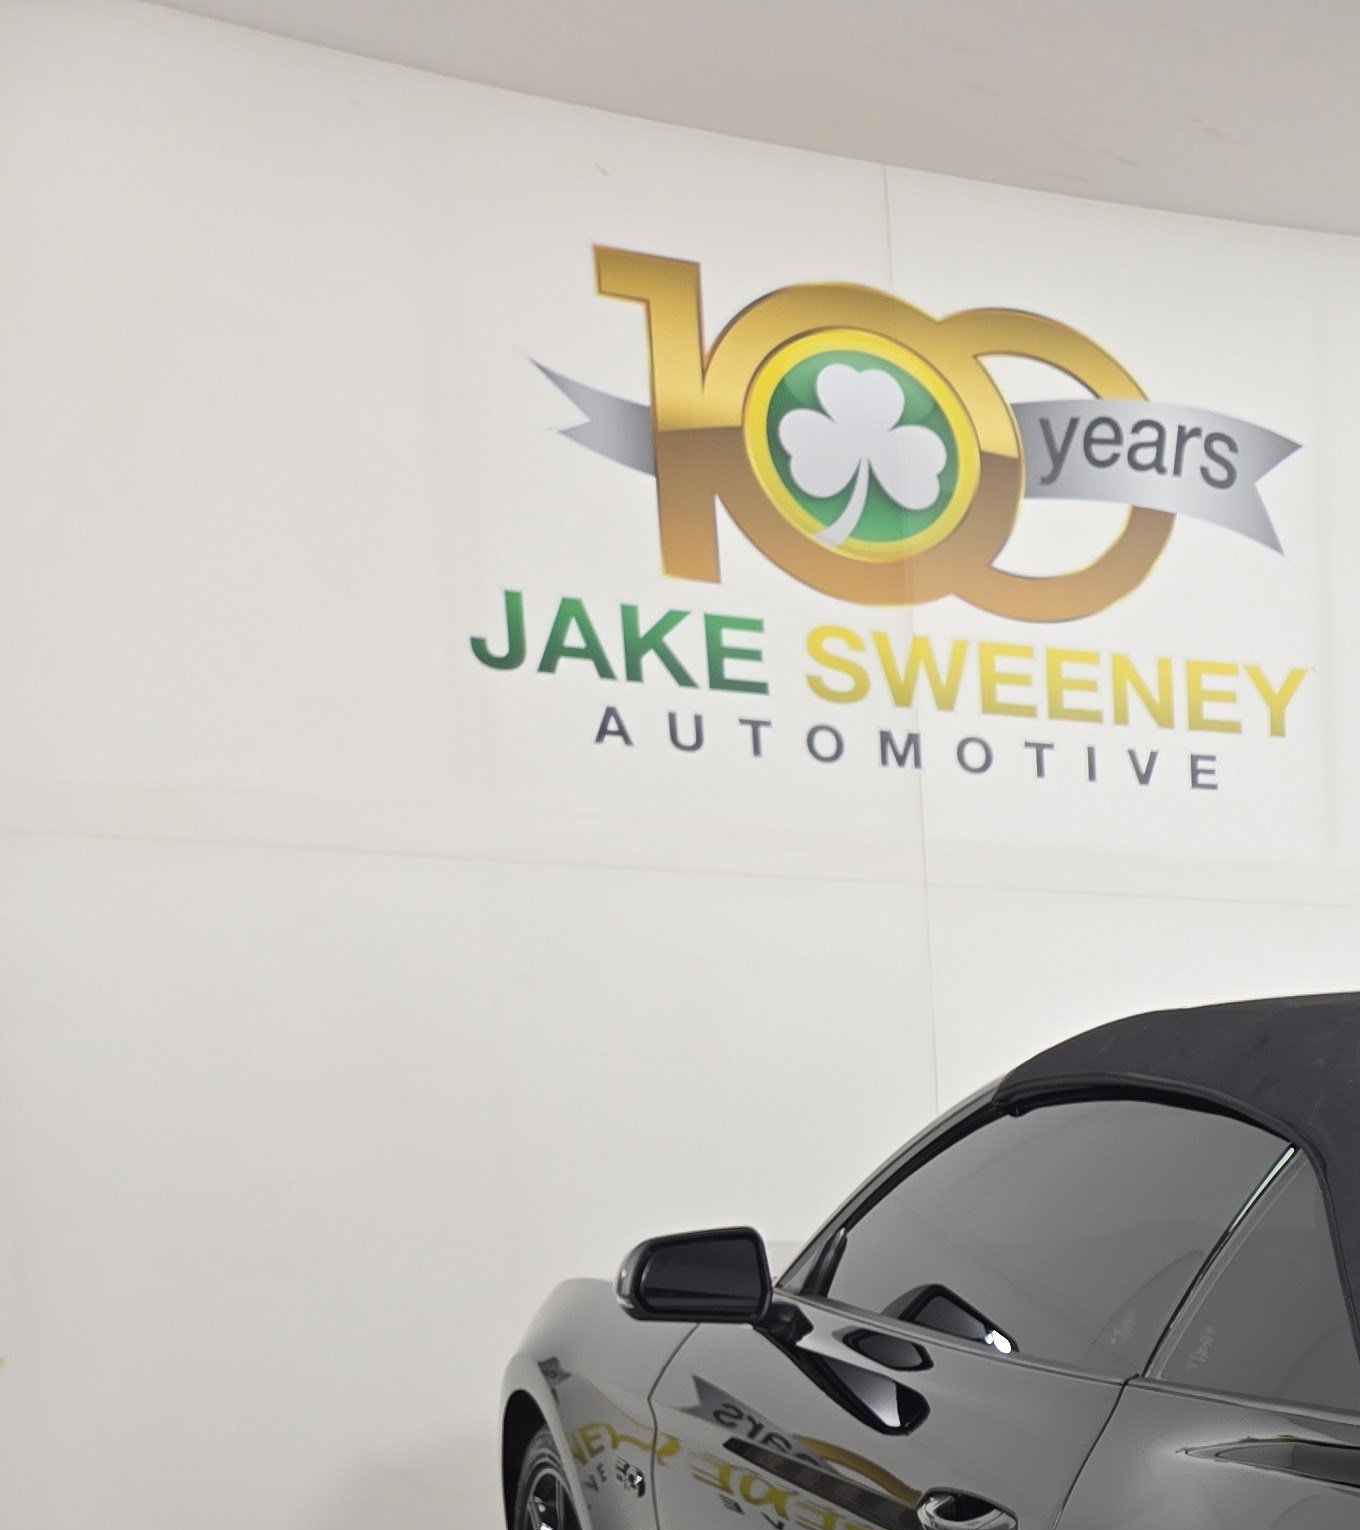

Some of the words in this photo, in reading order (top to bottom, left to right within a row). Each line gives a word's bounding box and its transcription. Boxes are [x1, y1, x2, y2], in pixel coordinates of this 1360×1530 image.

[1038, 414, 1239, 490] years
[469, 589, 770, 695] JAKE
[805, 624, 1308, 738] SWEENEY
[594, 705, 1220, 790] AUTOMOTIVE
